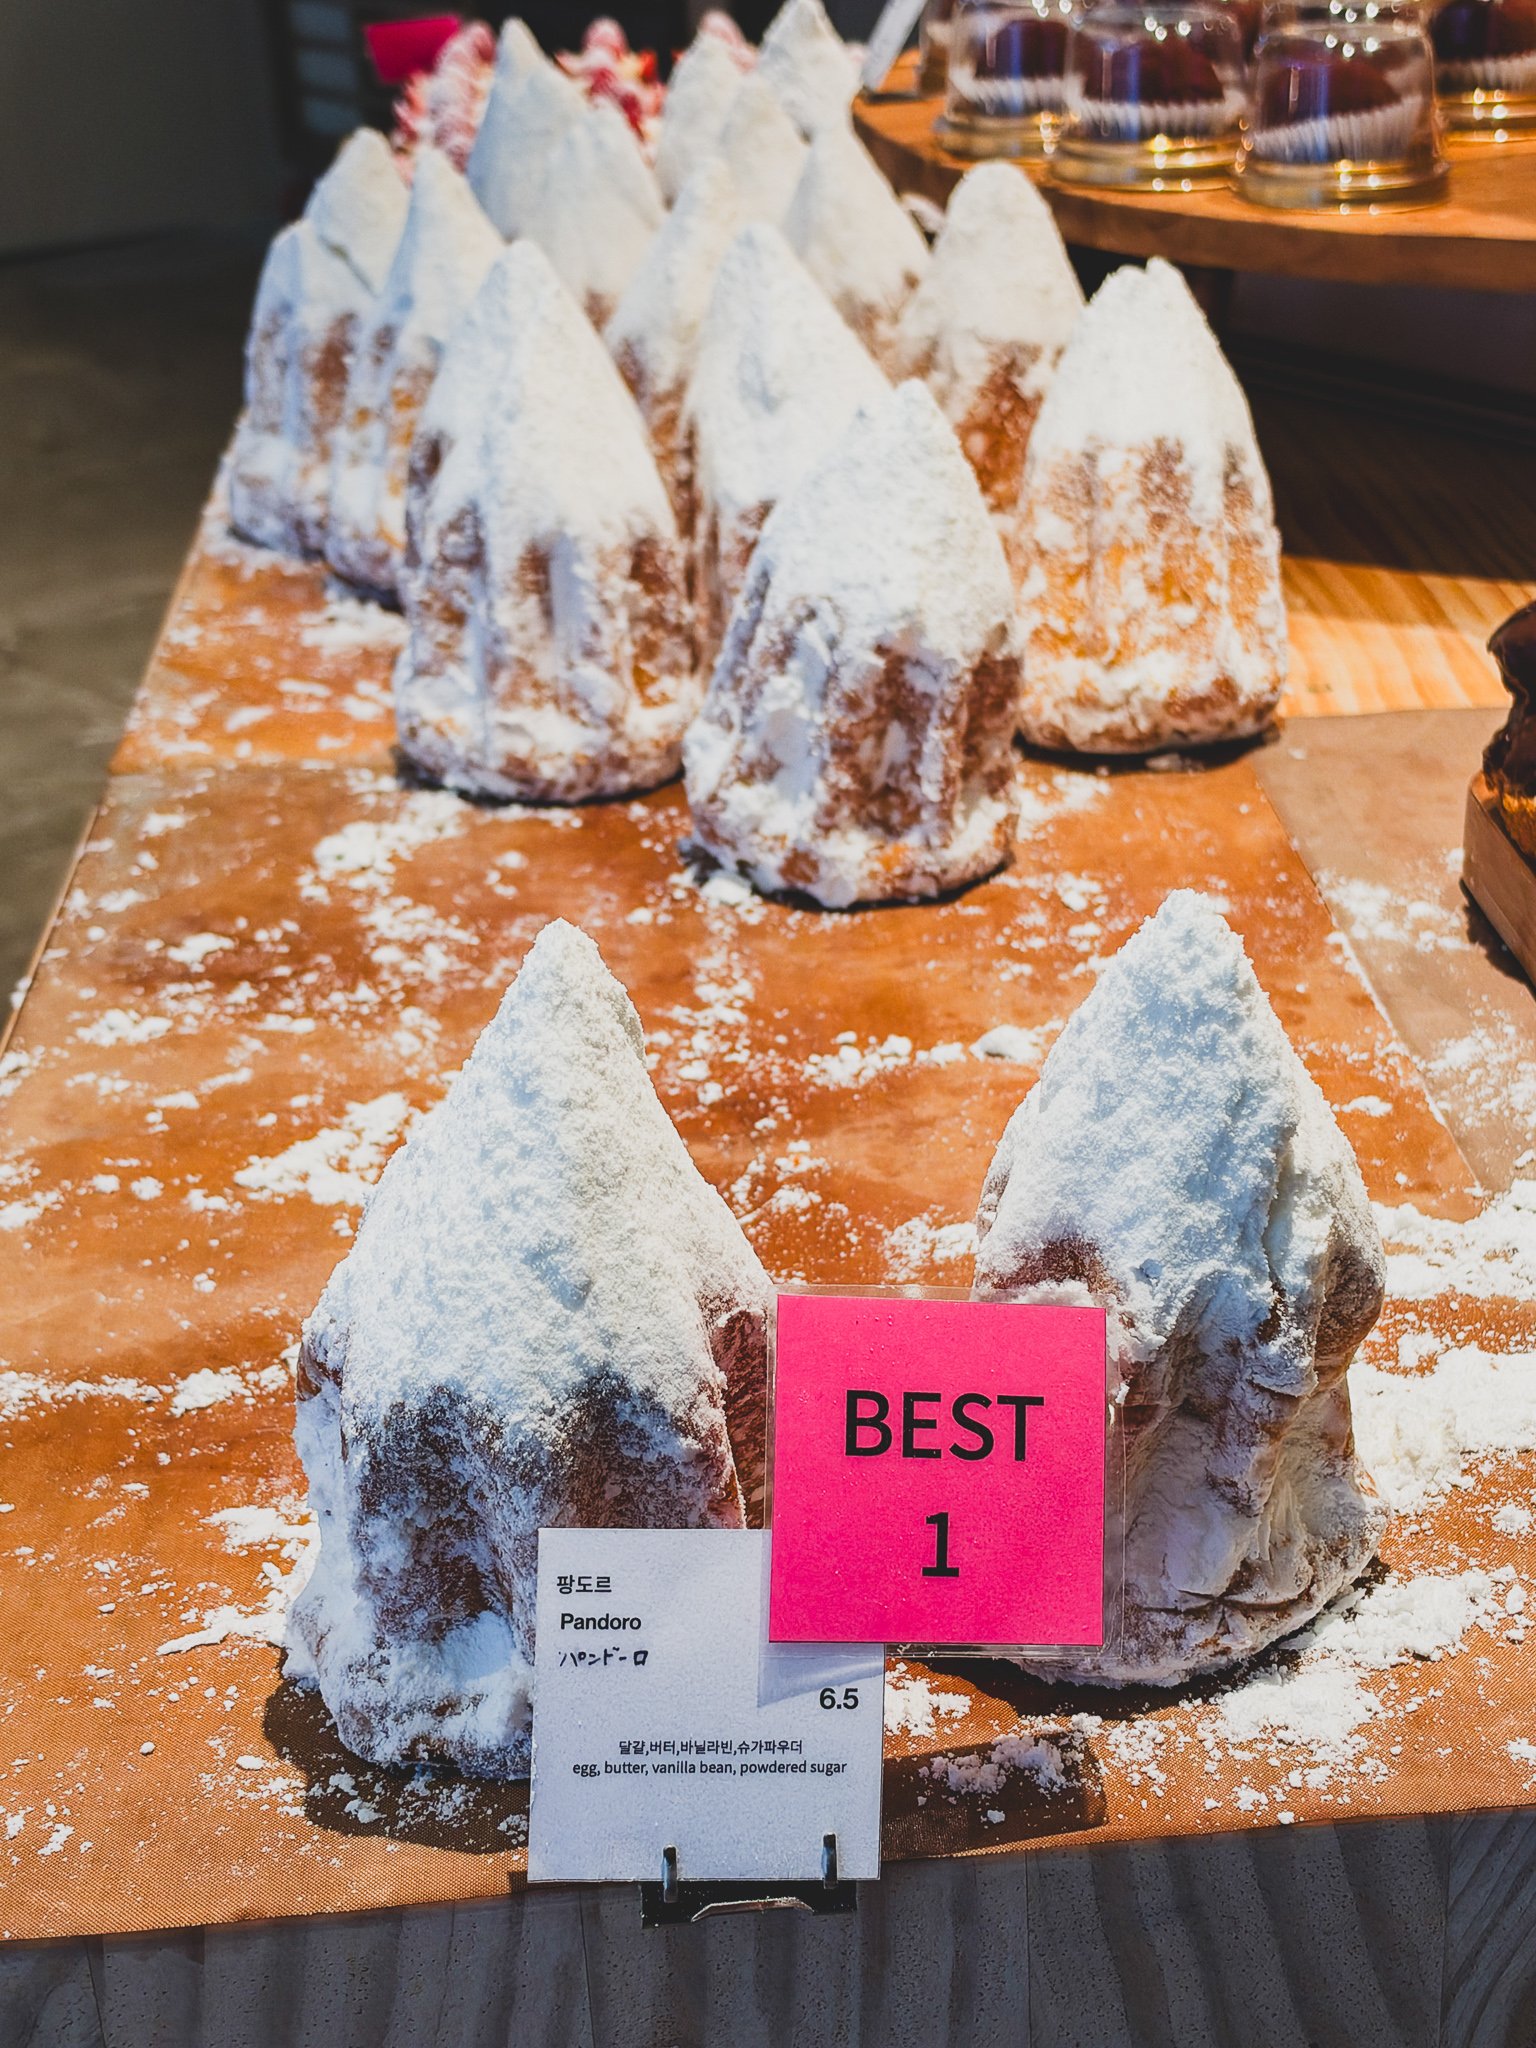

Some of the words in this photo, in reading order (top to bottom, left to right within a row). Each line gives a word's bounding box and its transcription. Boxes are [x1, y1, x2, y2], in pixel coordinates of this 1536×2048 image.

[845, 1389, 1045, 1462] BEST
[921, 1511, 960, 1578] 1
[556, 1574, 612, 1595] 팡도르
[560, 1612, 642, 1630] Pandoro
[558, 1646, 649, 1667] パンドーロ
[819, 1687, 859, 1710] 6.5
[572, 1763, 601, 1778] egg,
[604, 1760, 649, 1777] butter,
[651, 1760, 696, 1774] vanilla
[699, 1760, 737, 1776] bean,
[739, 1760, 807, 1777] powdered
[809, 1762, 848, 1777] sugar
